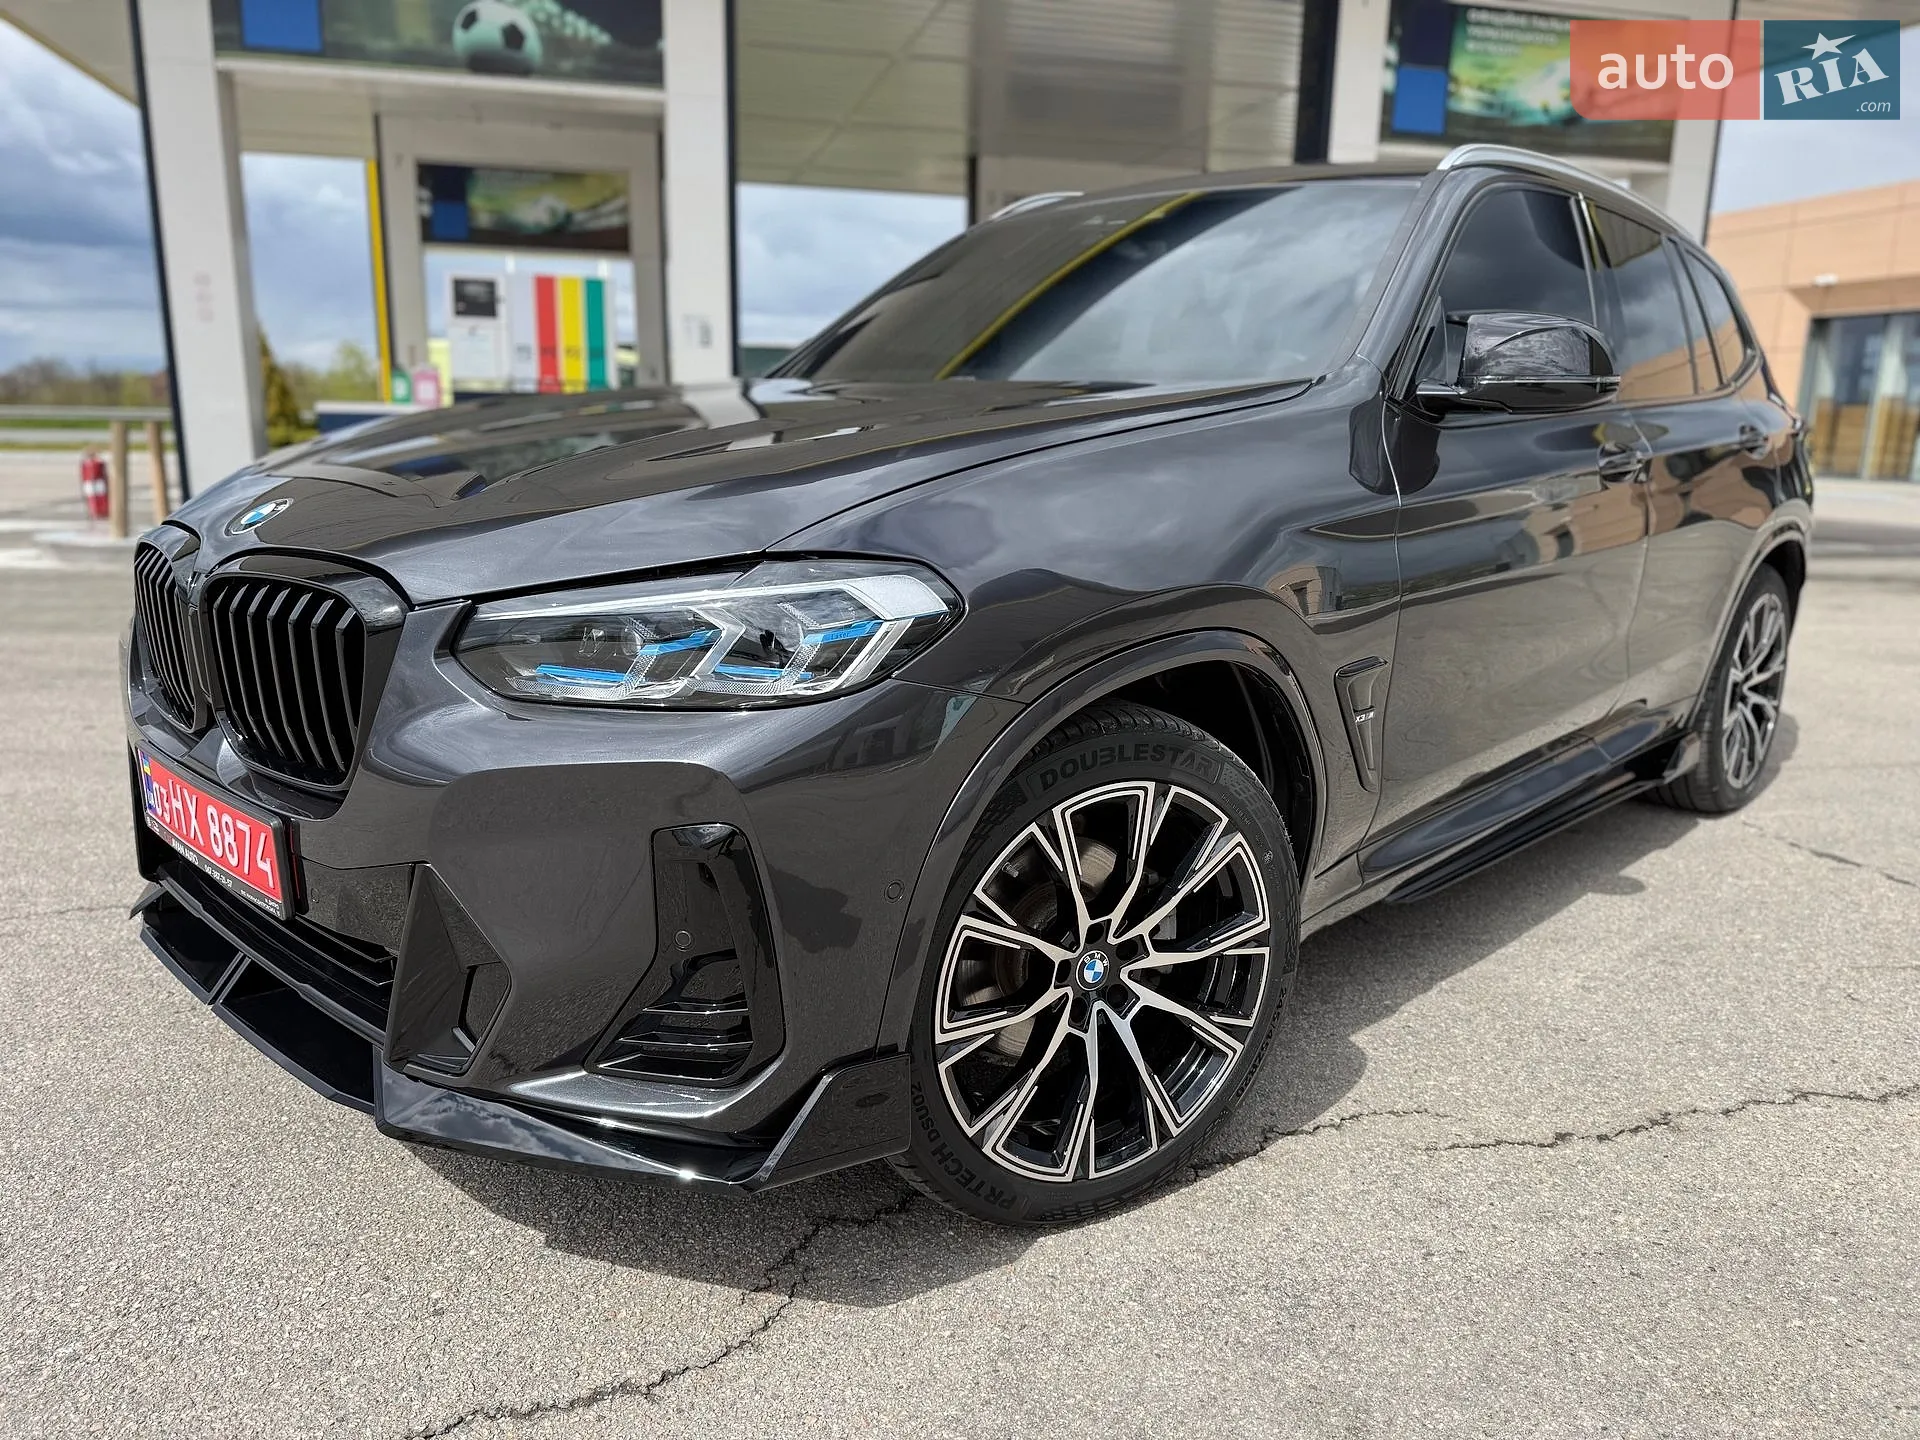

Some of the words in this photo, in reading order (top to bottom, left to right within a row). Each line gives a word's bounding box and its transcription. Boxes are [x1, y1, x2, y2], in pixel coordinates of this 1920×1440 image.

[1040, 743, 1215, 791] DOUBLESTAR
[206, 804, 275, 889] 8874
[1084, 952, 1109, 967] BMW
[910, 1081, 941, 1143] DSU02
